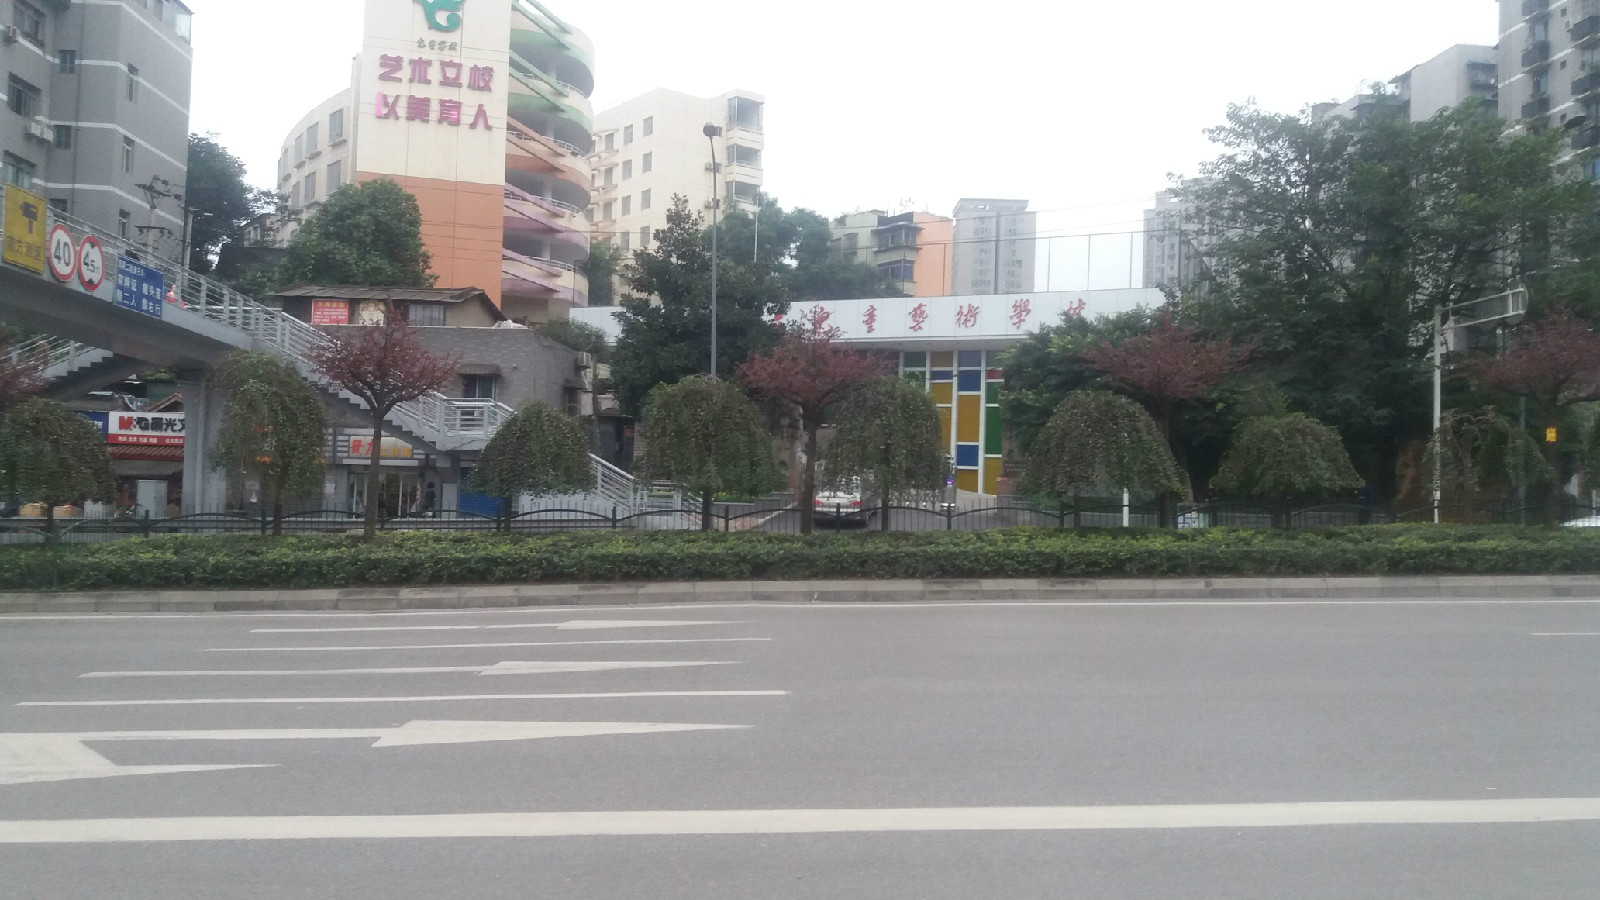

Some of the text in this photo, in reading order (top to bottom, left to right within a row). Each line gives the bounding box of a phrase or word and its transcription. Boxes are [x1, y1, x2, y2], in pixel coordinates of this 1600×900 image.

[378, 53, 495, 92] 艺术立校
[376, 91, 493, 131] 以美育人
[54, 238, 71, 267] 40
